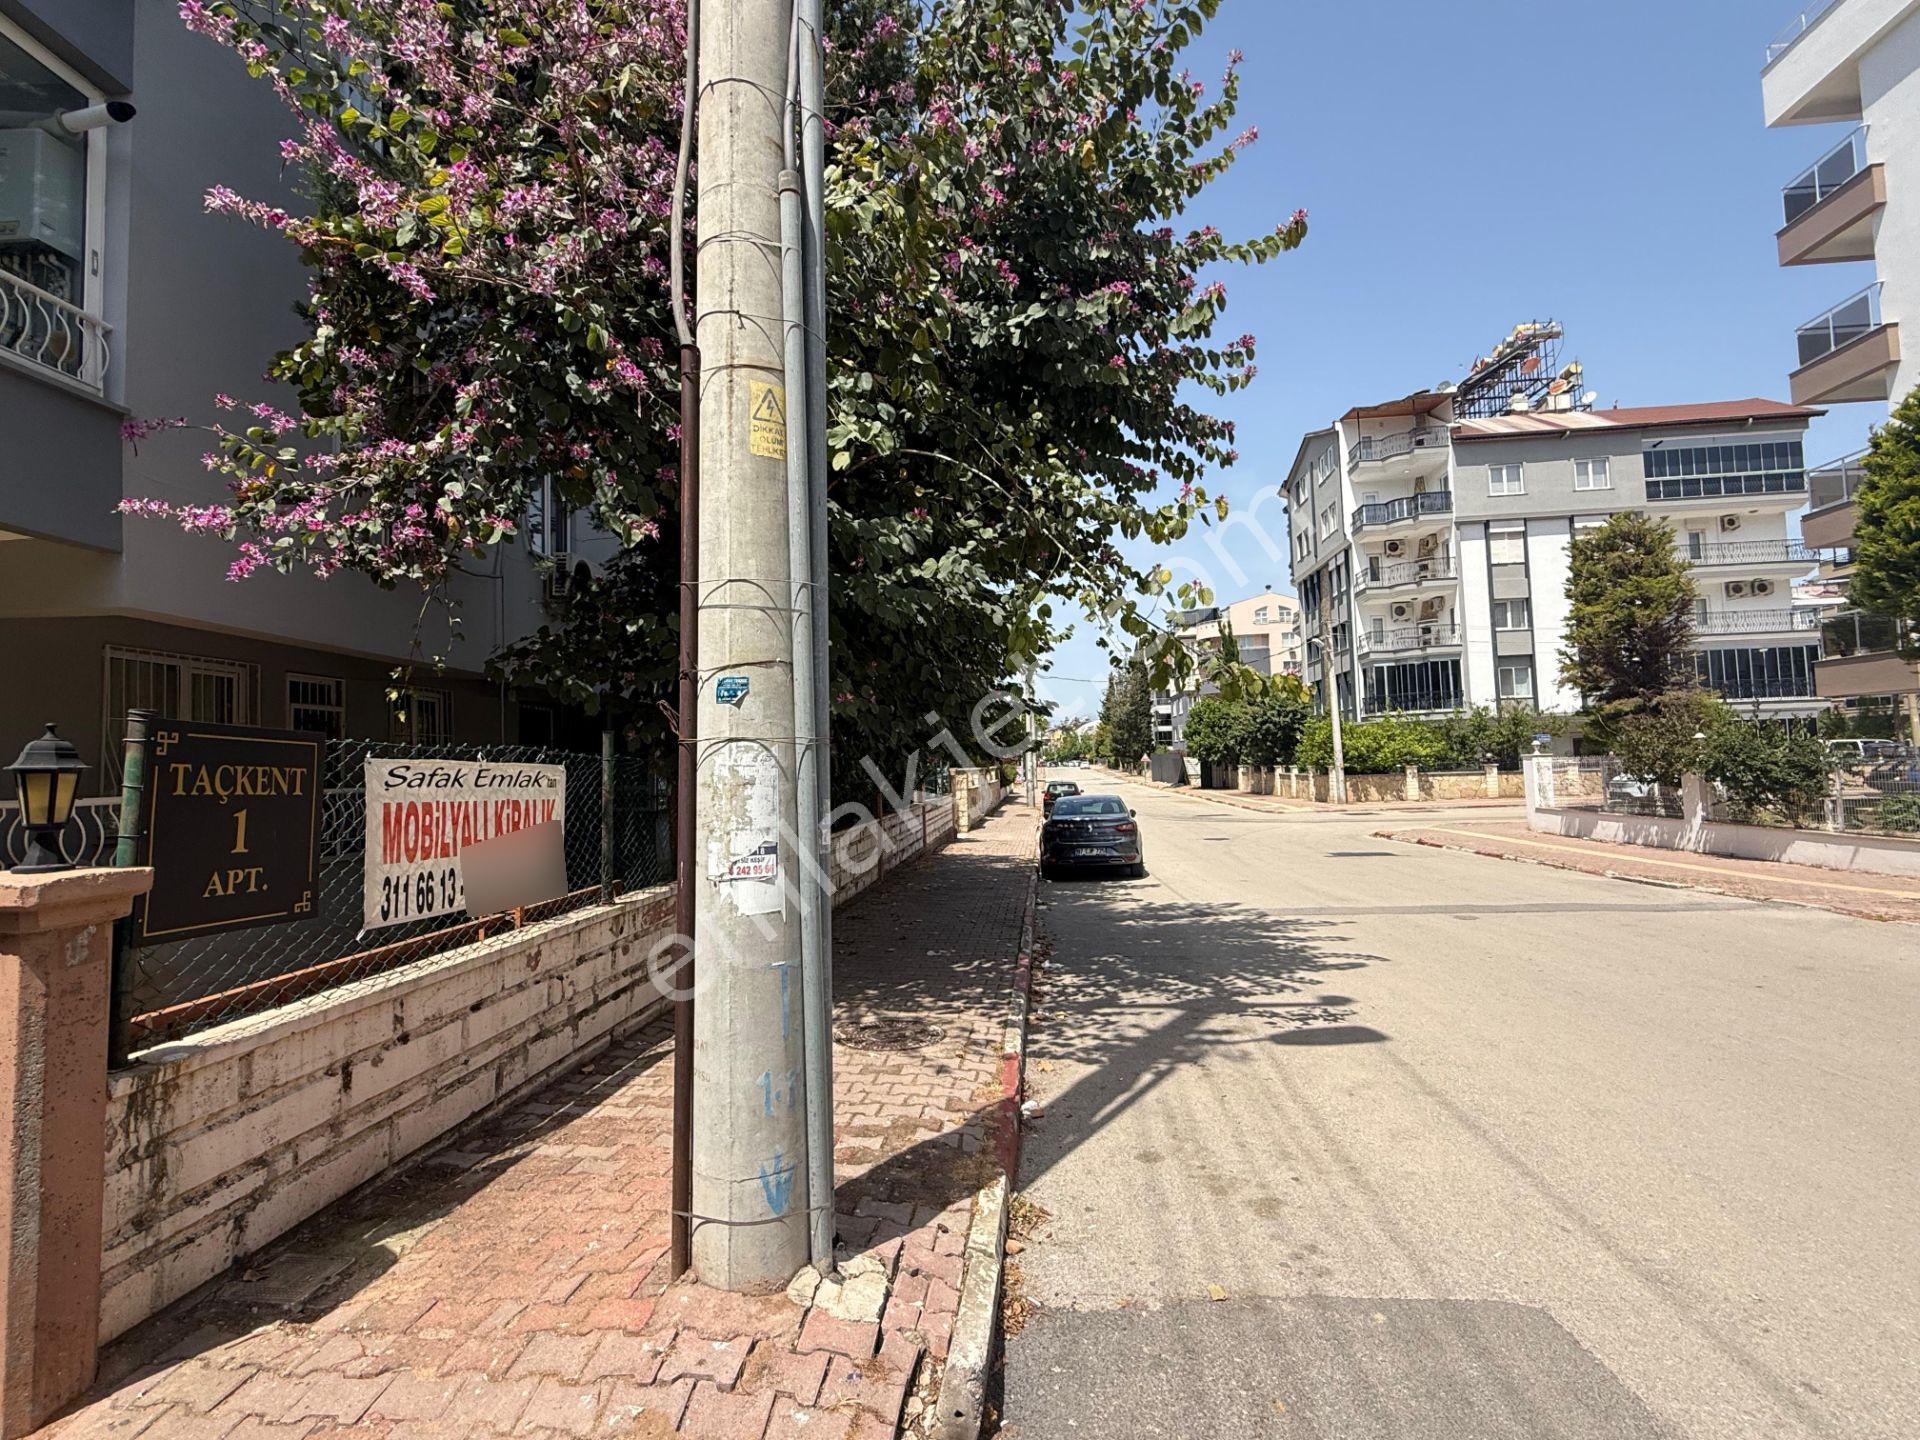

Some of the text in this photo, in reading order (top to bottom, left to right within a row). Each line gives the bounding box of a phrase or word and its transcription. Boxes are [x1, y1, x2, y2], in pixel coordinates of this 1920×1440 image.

[170, 763, 307, 804] TAÇKENT
[384, 765, 468, 791] Şafak
[230, 809, 249, 853] 1
[203, 867, 269, 898] APT.
[381, 867, 456, 922] 311 66 13
